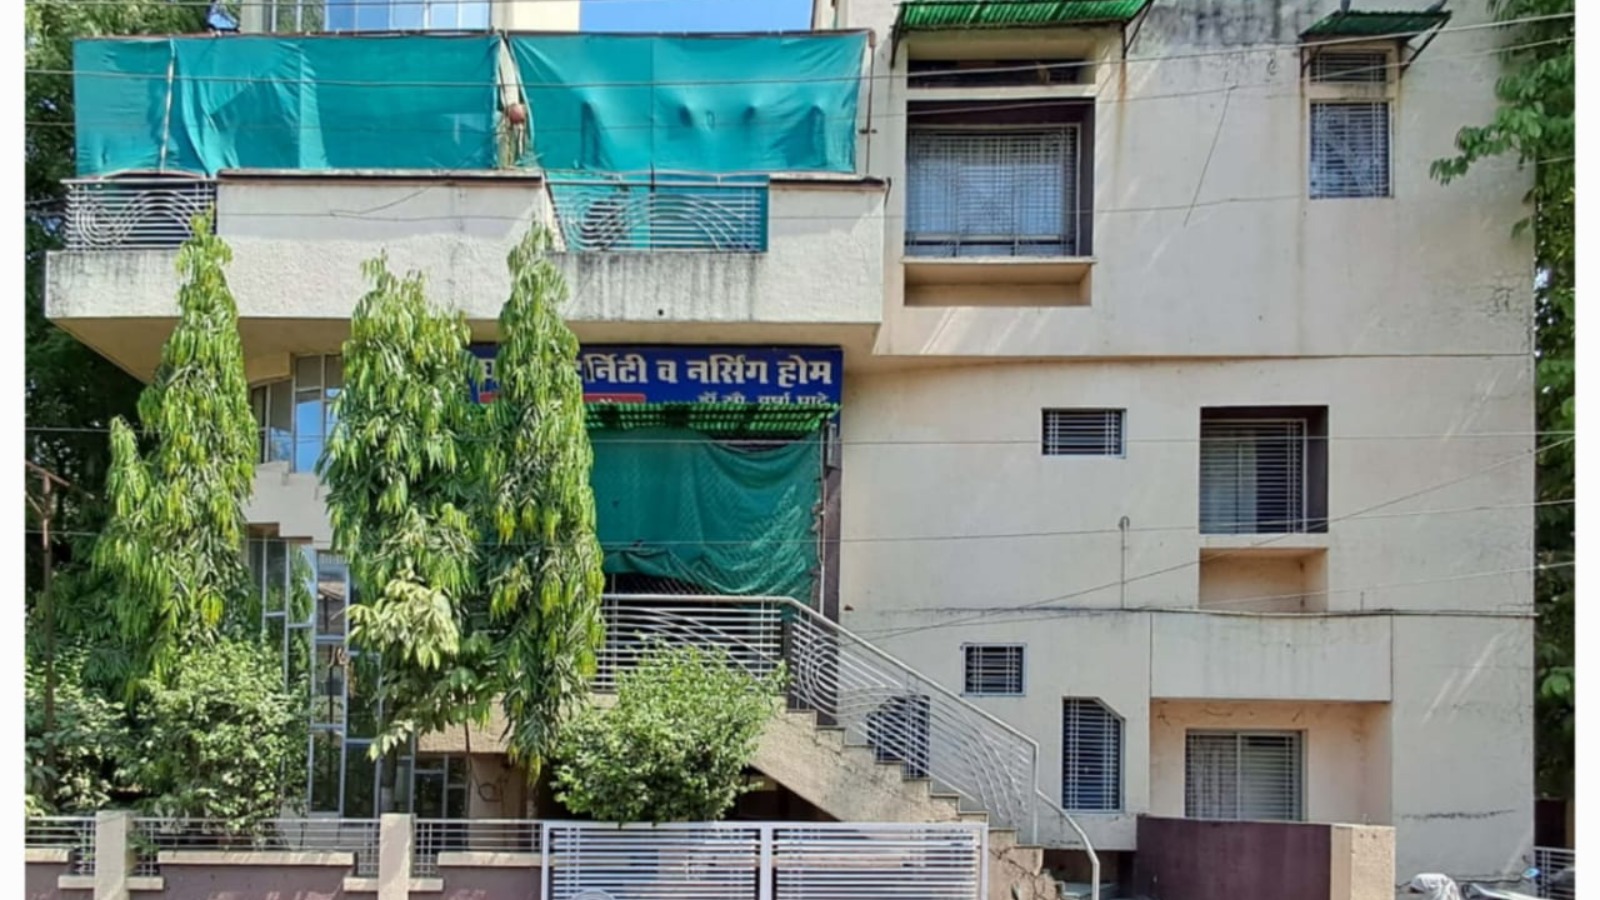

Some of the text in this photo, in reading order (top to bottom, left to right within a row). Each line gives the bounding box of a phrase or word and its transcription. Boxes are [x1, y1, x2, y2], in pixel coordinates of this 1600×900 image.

[576, 353, 833, 388] र्निटी व नर्सिंग होम
